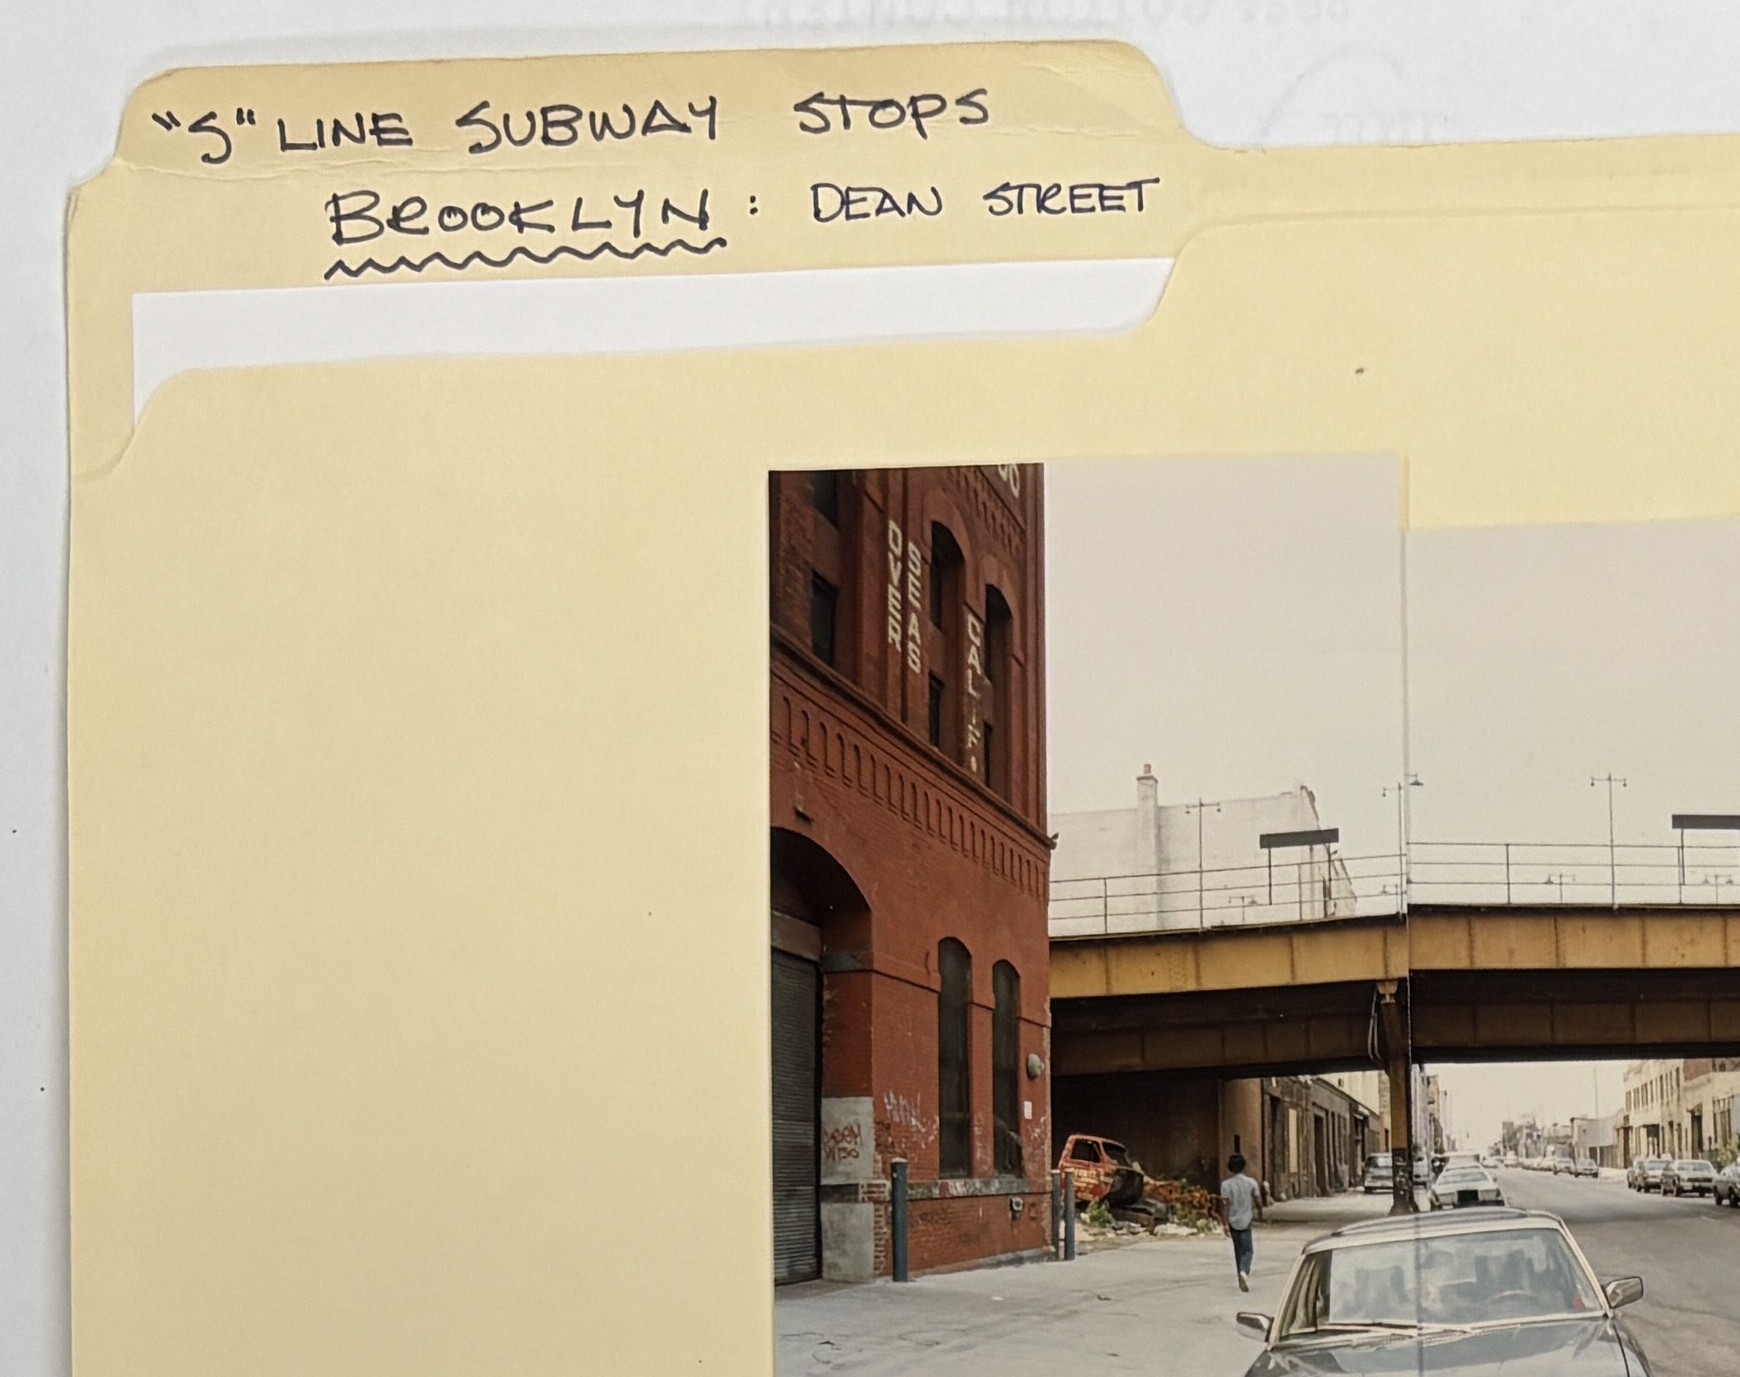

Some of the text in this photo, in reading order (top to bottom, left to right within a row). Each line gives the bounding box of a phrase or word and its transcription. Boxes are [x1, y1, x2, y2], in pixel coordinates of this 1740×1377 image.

[277, 112, 414, 152] LINE
[455, 95, 717, 154] SUBWAY
[793, 88, 989, 134] STOPS
[810, 182, 943, 223] DEAN
[982, 177, 1160, 216] STREET
[888, 519, 903, 652] OVER
[907, 541, 922, 674] SEAS
